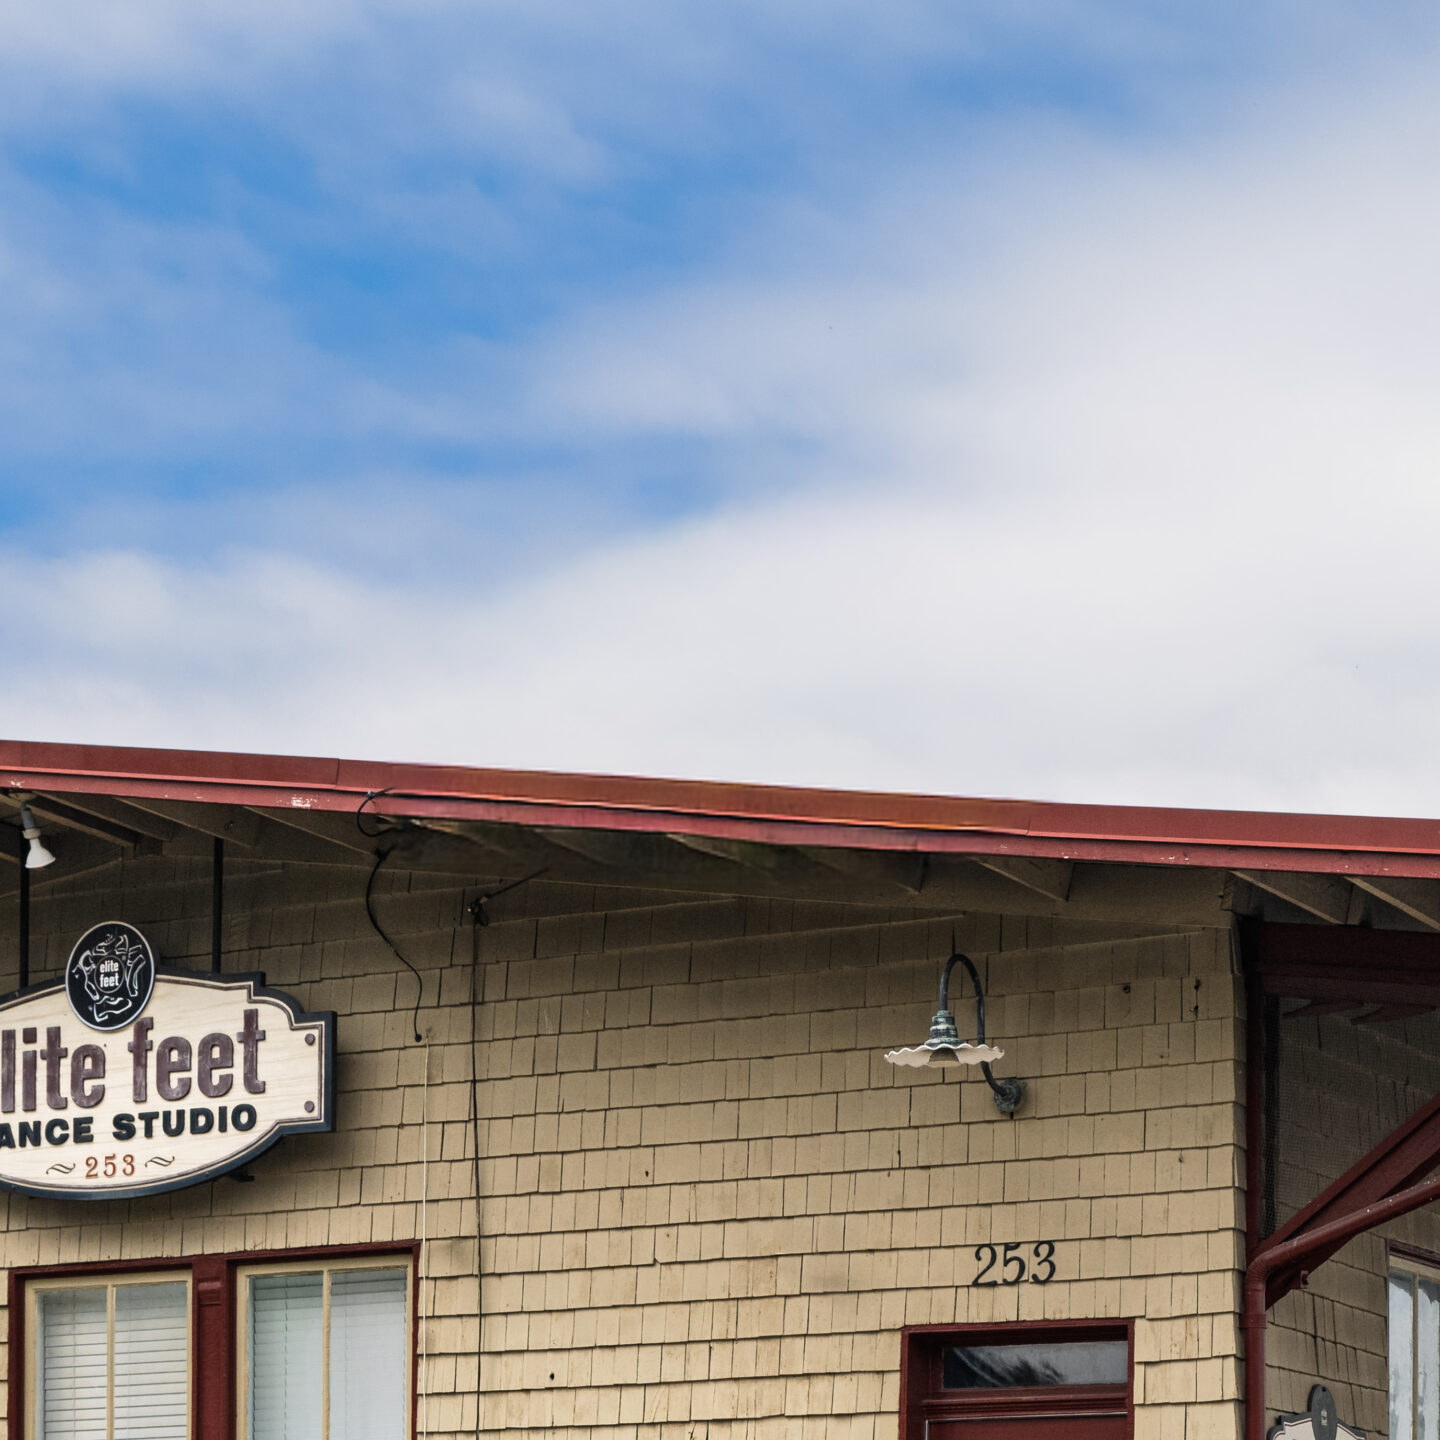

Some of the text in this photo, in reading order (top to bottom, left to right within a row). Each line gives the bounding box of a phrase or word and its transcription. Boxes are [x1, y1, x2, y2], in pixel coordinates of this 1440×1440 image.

[100, 960, 119, 973] elite
[100, 973, 119, 988] feet
[128, 1008, 266, 1103] feet
[112, 1103, 257, 1141] STUDIO
[85, 1154, 136, 1179] 253
[972, 1241, 1057, 1286] 253
